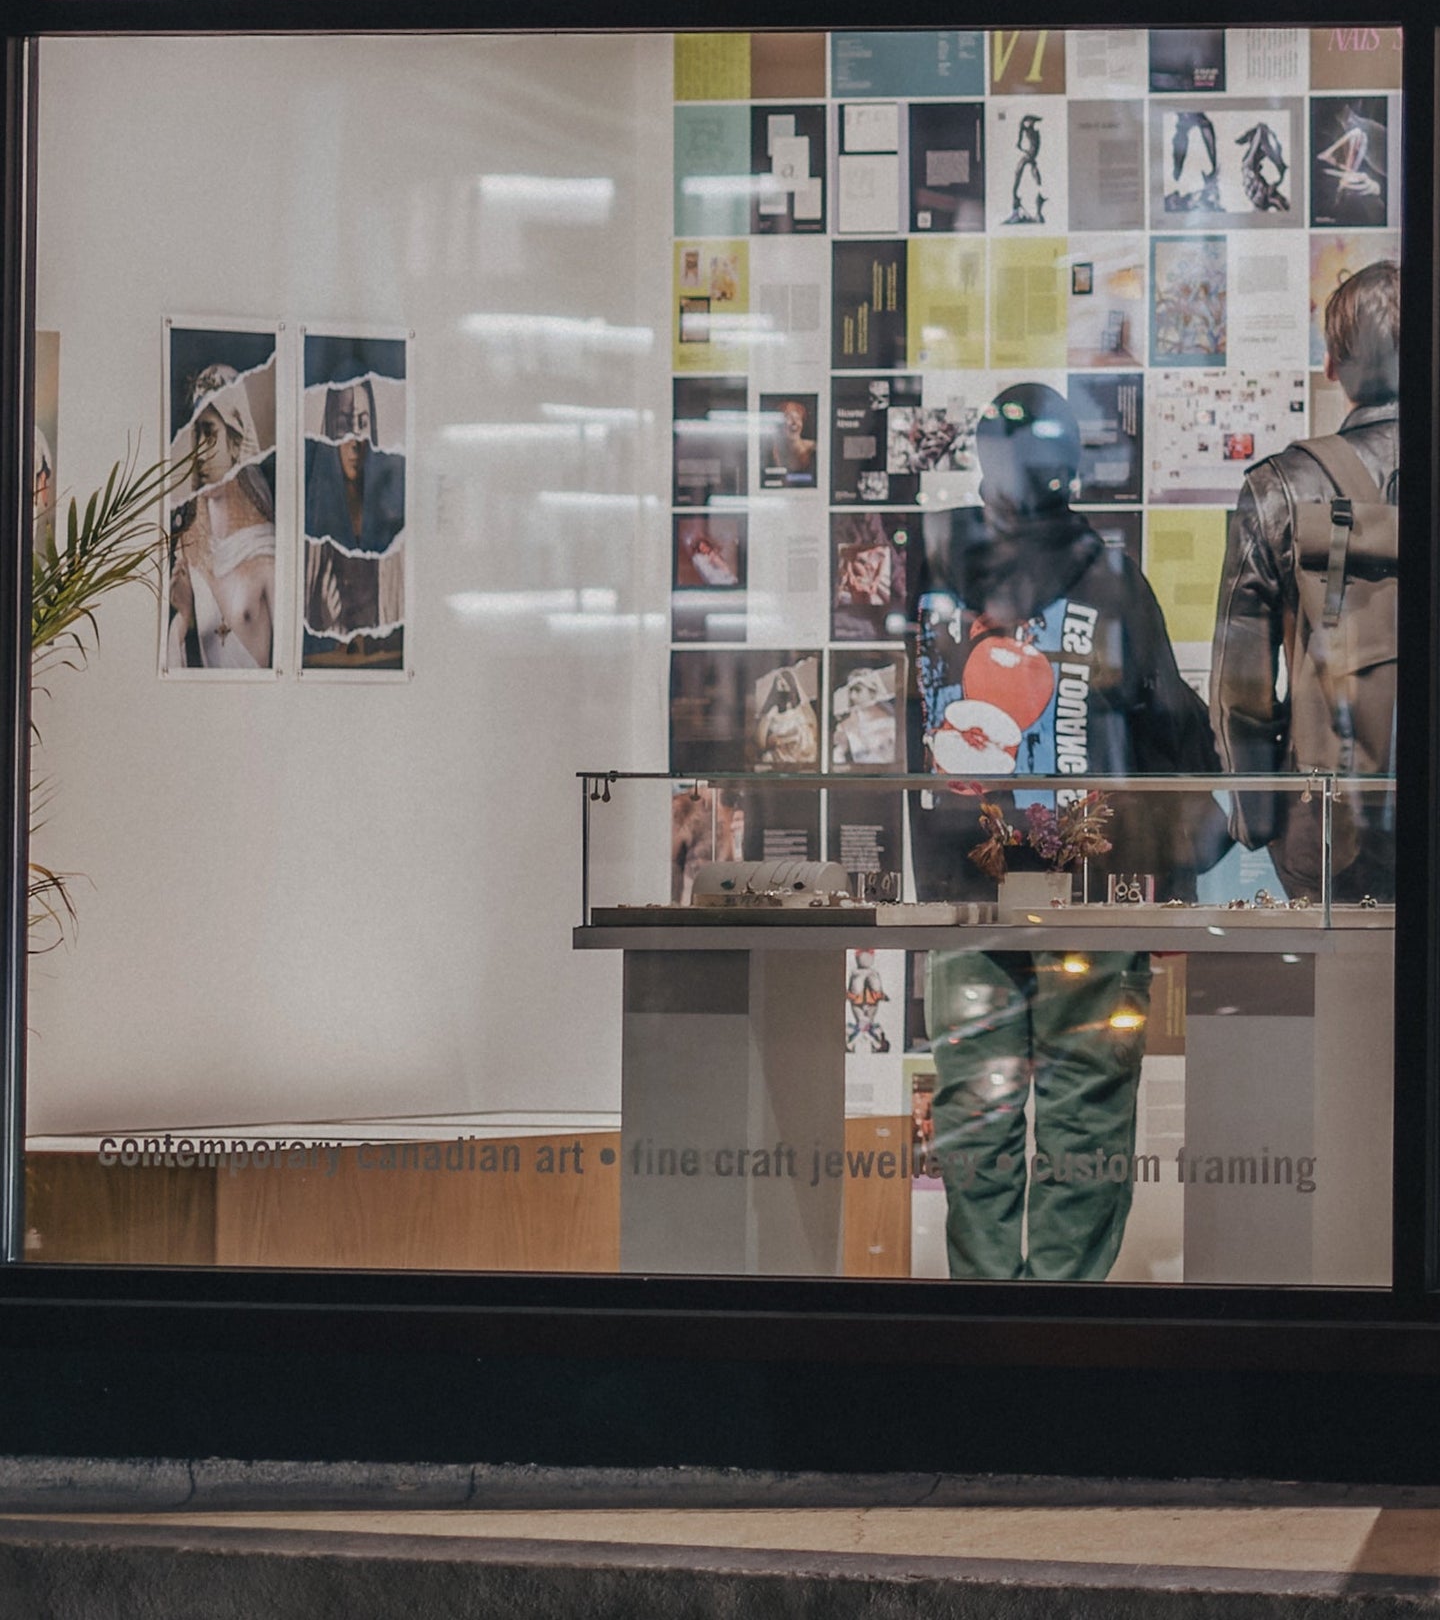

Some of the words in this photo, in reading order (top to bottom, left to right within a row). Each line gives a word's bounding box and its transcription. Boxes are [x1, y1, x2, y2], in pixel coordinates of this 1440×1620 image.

[98, 1134, 342, 1177] contemporary
[356, 1136, 521, 1174] canadian
[535, 1140, 585, 1175] art
[631, 1139, 699, 1177] fine
[714, 1142, 797, 1179] craft
[809, 1143, 978, 1188] jewellery
[1030, 1149, 1161, 1183] custom
[1176, 1147, 1318, 1194] framing
